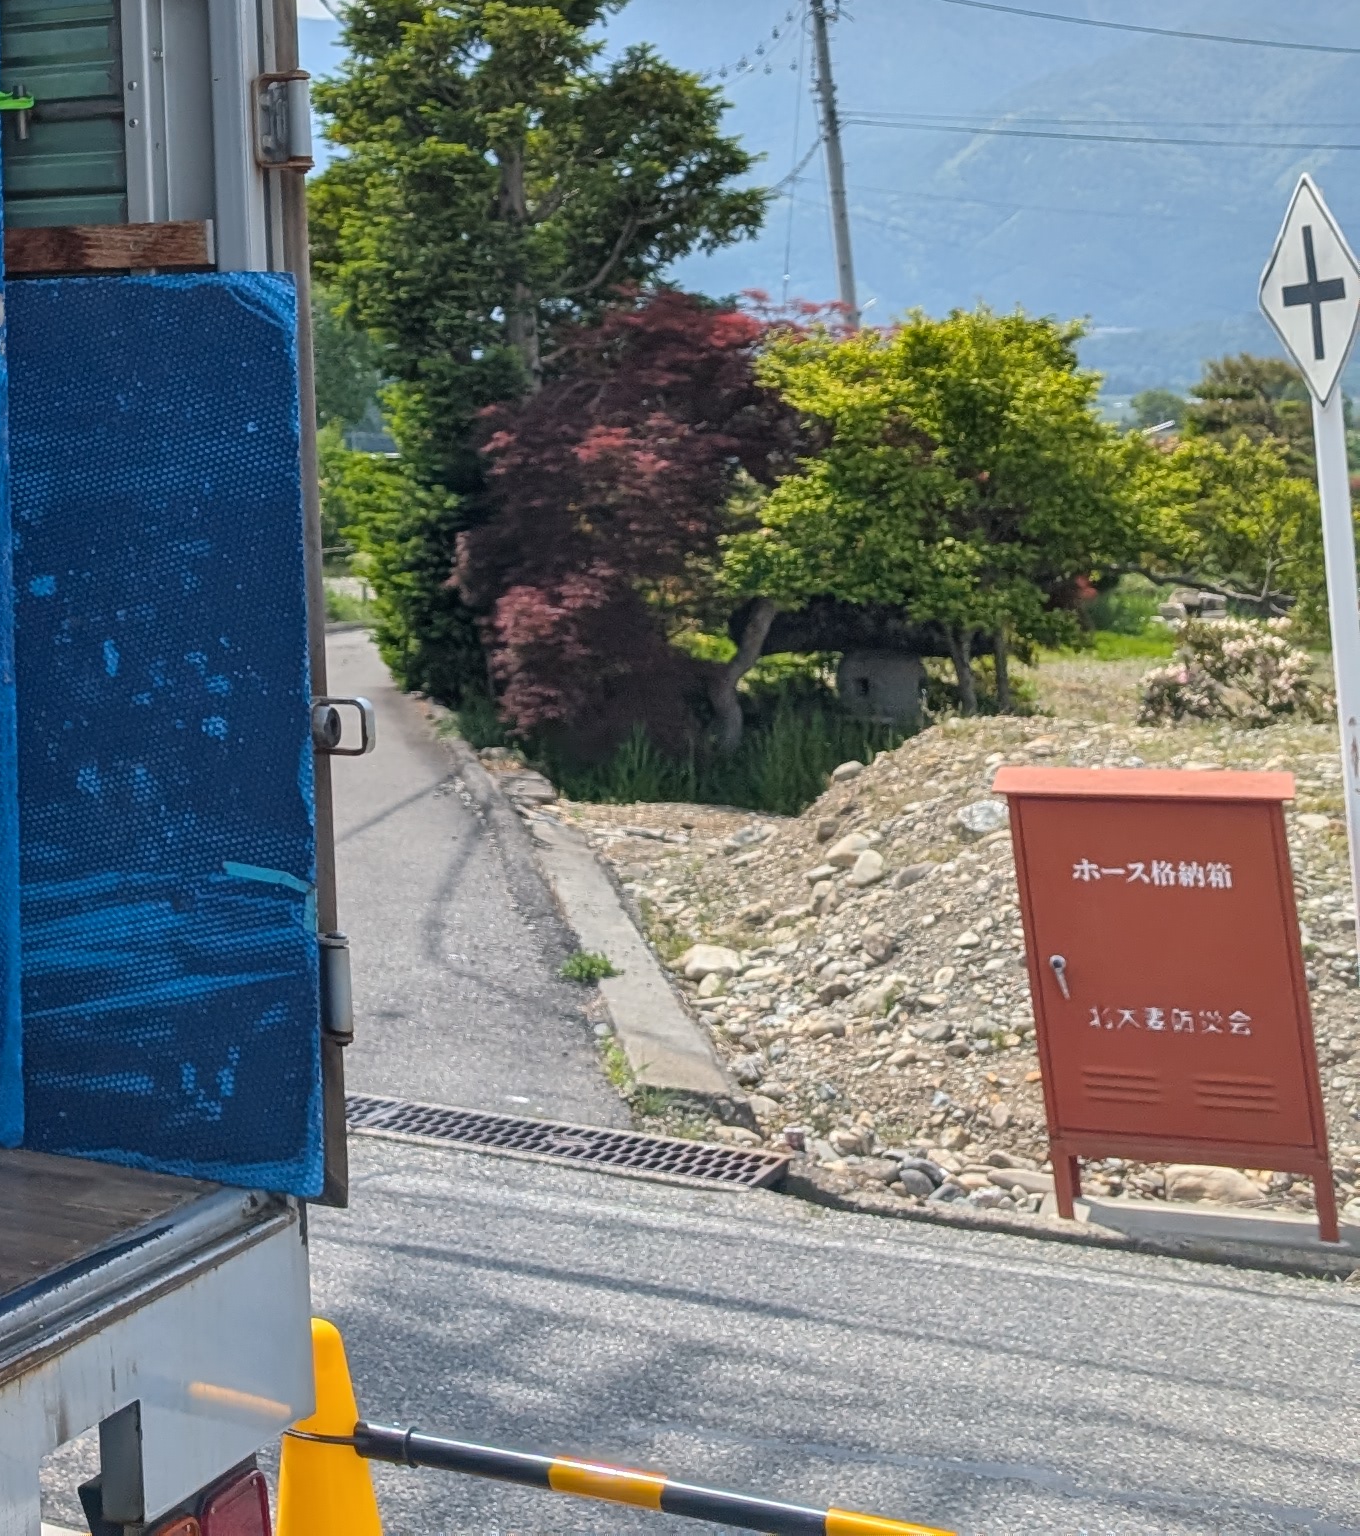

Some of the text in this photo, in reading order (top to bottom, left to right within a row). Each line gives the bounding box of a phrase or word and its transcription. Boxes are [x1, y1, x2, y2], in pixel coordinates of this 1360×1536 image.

[1072, 858, 1232, 889] ホース格納箱
